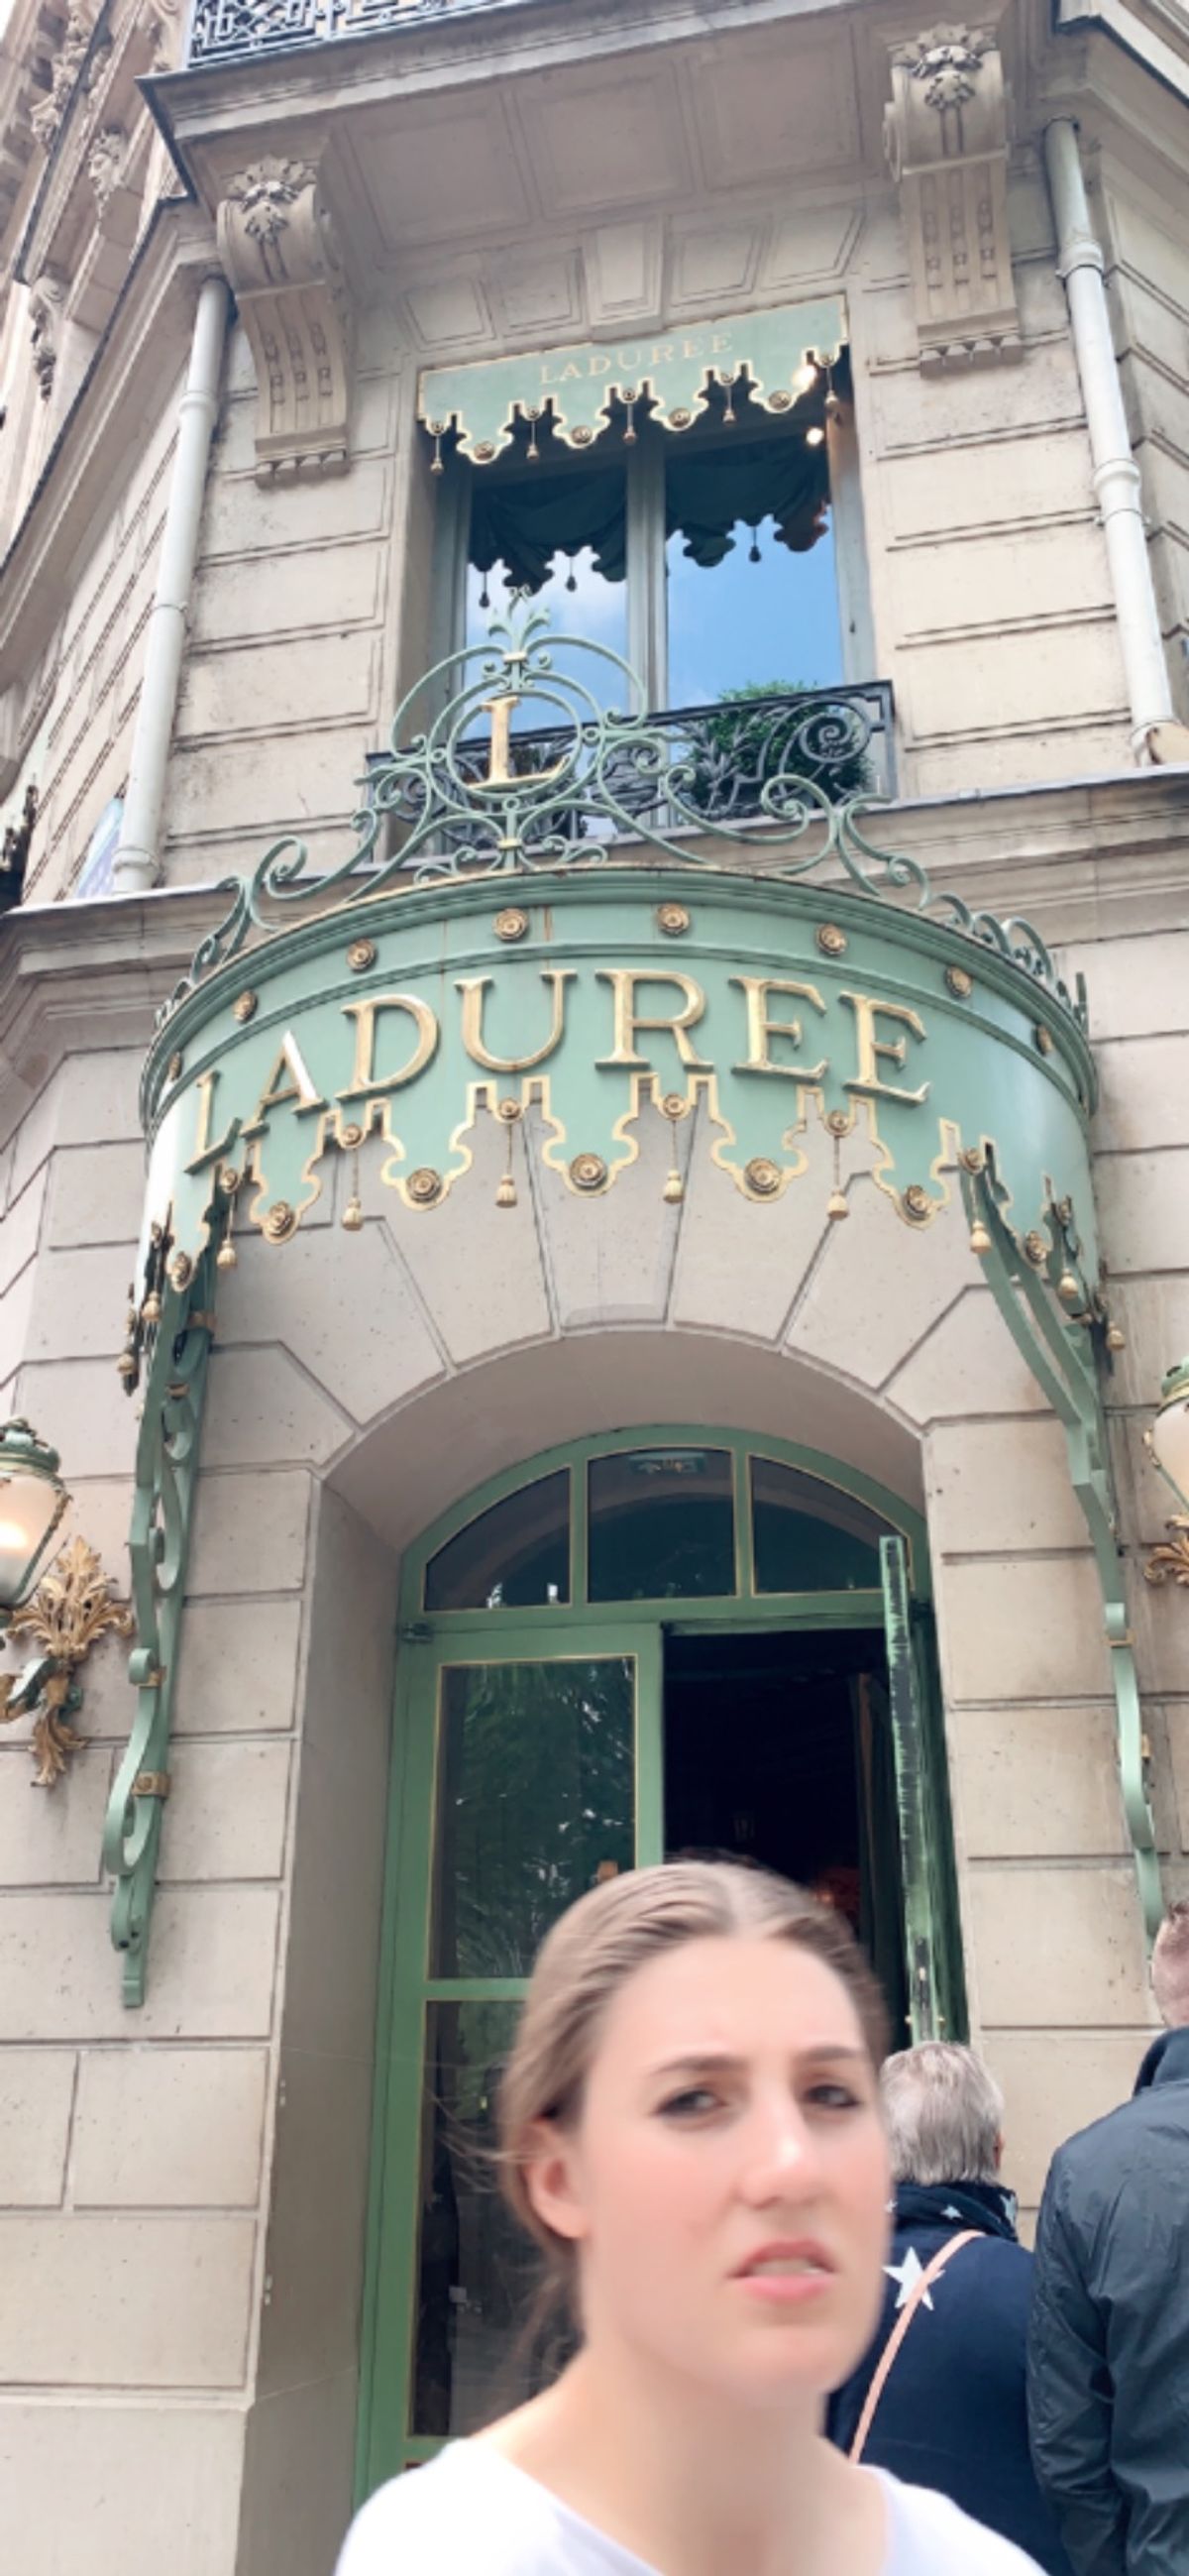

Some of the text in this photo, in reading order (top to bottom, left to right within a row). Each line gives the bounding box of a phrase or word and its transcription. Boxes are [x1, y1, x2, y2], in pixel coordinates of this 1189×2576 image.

[539, 331, 733, 385] LADUREE
[465, 696, 571, 790] L
[184, 968, 931, 1174] LADUREE
